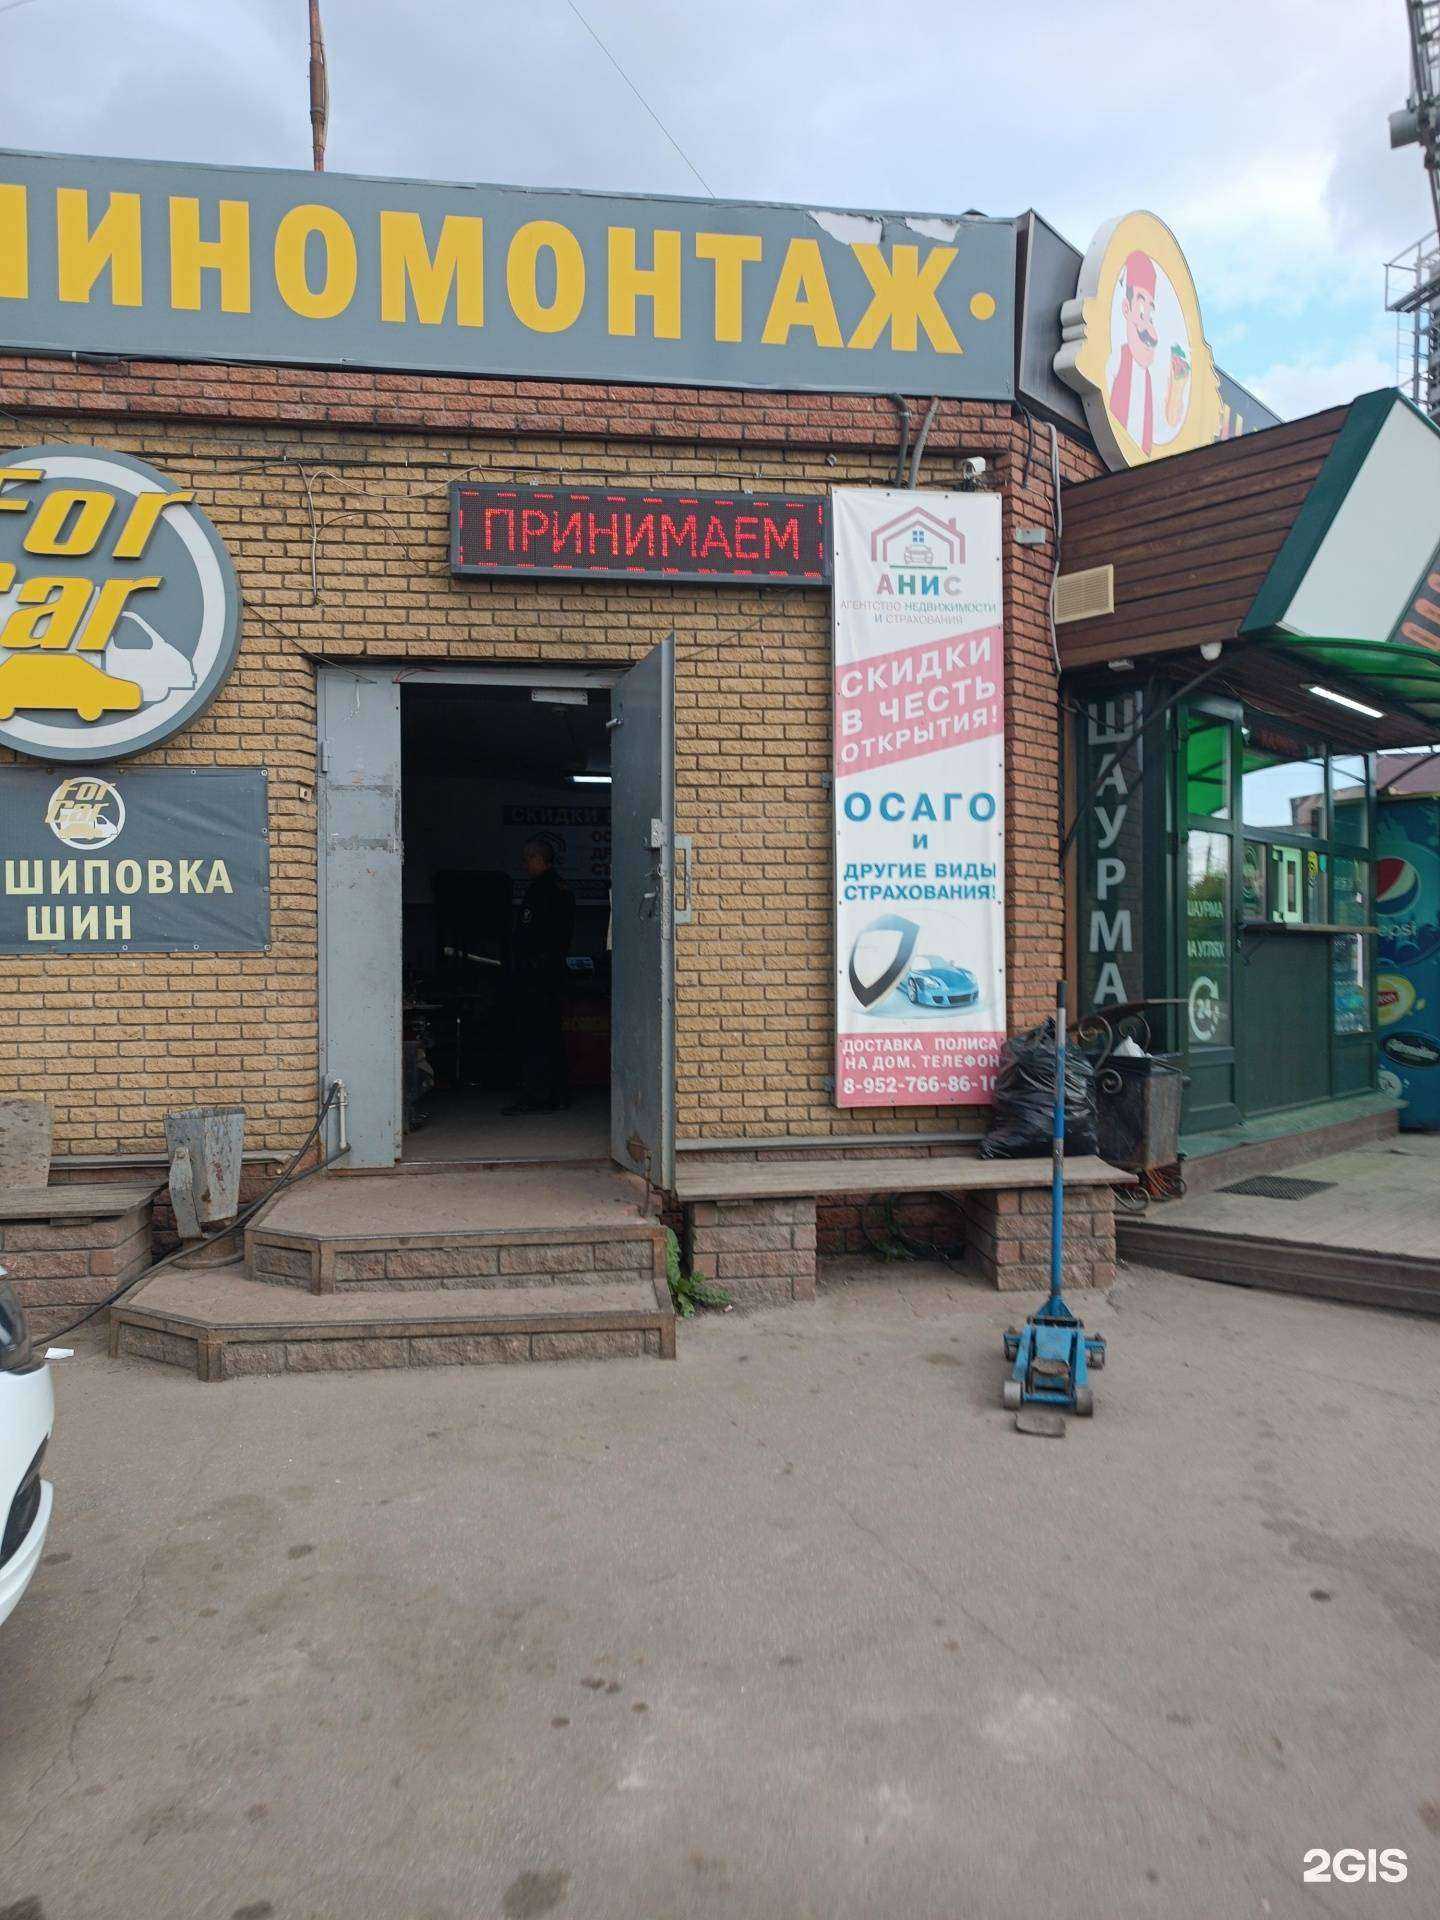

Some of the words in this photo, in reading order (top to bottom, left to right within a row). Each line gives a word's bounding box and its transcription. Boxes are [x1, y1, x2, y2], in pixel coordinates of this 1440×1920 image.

[0, 184, 964, 354] ИНОМОНТАЖ
[484, 507, 799, 560] ПРИНИМАЕМ
[876, 573, 962, 596] АНИС
[0, 561, 165, 651] ar
[841, 600, 902, 612] АГЕНТСТВО
[904, 601, 997, 614] НЕДВИЖИМОСТИ
[874, 613, 883, 624] И
[886, 613, 963, 625] СТРАХОВАНИЯ
[840, 636, 991, 699] СКИДКИ
[841, 708, 863, 746] В
[879, 675, 996, 734] ЧЕСТЬ
[841, 704, 998, 764] ОТКРЫТИЯ!
[843, 791, 996, 822] ОСАГО
[912, 833, 928, 849] И
[1087, 700, 1134, 1005] ШАУРМА
[5, 859, 234, 895] ШИПОВКА
[843, 863, 926, 882] ДРУГИЕ
[935, 863, 996, 880] ВИДЫ
[843, 884, 996, 901] СТРАХОВАНИЯ!
[27, 905, 132, 941] ШИН
[842, 1038, 923, 1055] ДОСТАВКА
[934, 1037, 998, 1051] ПОЛИСА
[845, 1056, 868, 1070] НА
[921, 1054, 1000, 1068] ТЕЛЕФОН
